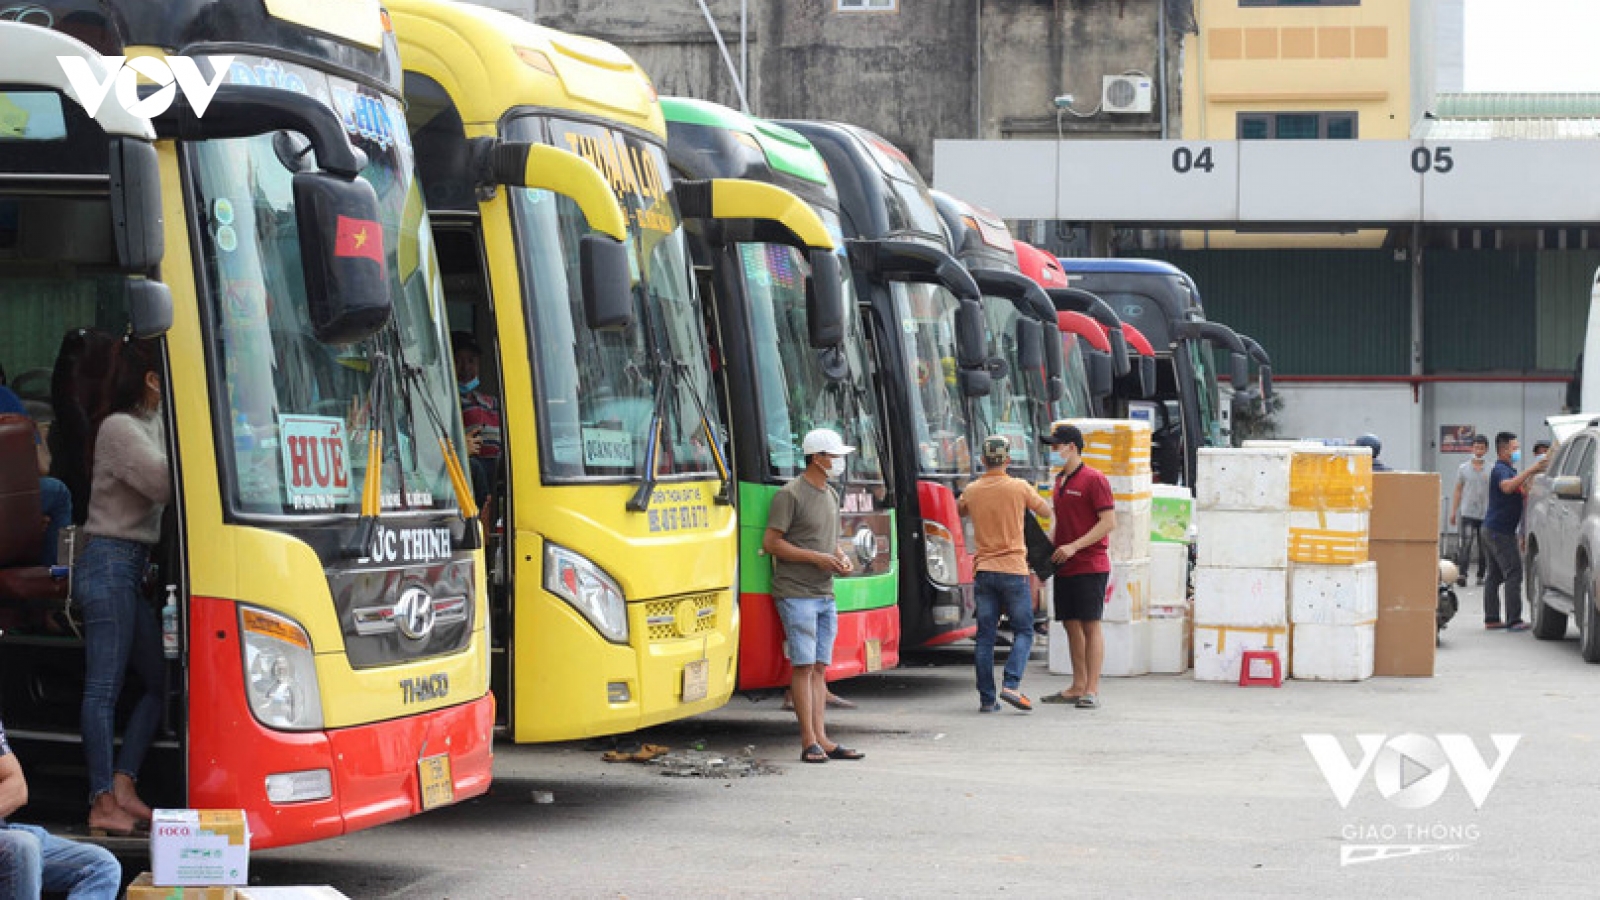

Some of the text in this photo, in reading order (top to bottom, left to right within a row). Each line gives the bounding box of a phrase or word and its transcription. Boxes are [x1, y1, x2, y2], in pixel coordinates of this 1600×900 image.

[1172, 147, 1214, 173] 04
[1411, 147, 1453, 173] 05
[287, 422, 348, 488] HUẾ
[400, 528, 452, 563] THỊNH
[400, 672, 449, 704] THACO
[159, 827, 190, 836] FOCO
